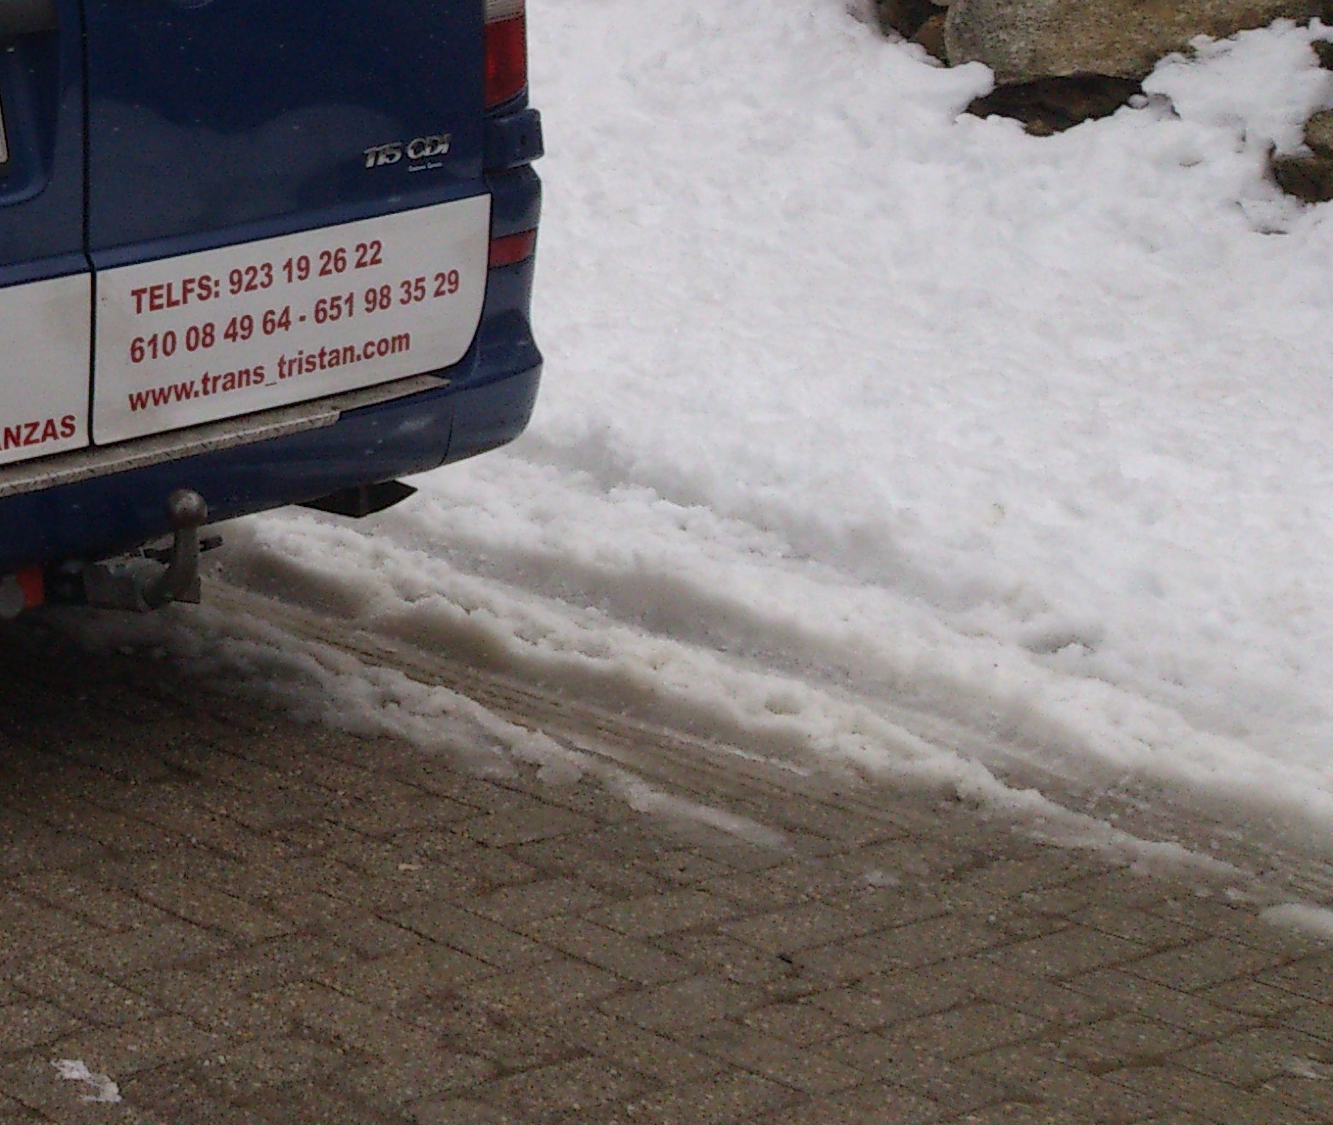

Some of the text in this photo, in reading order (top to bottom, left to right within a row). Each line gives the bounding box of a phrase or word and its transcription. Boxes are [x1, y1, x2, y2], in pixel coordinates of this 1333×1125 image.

[363, 142, 402, 168] 115
[407, 134, 451, 160] CDI
[130, 239, 383, 315] TELFS: 923 19 26 22
[130, 330, 177, 364] 610
[185, 322, 215, 352] 08
[223, 314, 254, 343] 49
[262, 305, 292, 335] 64
[314, 292, 354, 324] 651
[364, 284, 392, 313] 98
[399, 276, 426, 305] 35
[434, 269, 460, 298] 29
[128, 332, 411, 412] www.trans_tristan.com
